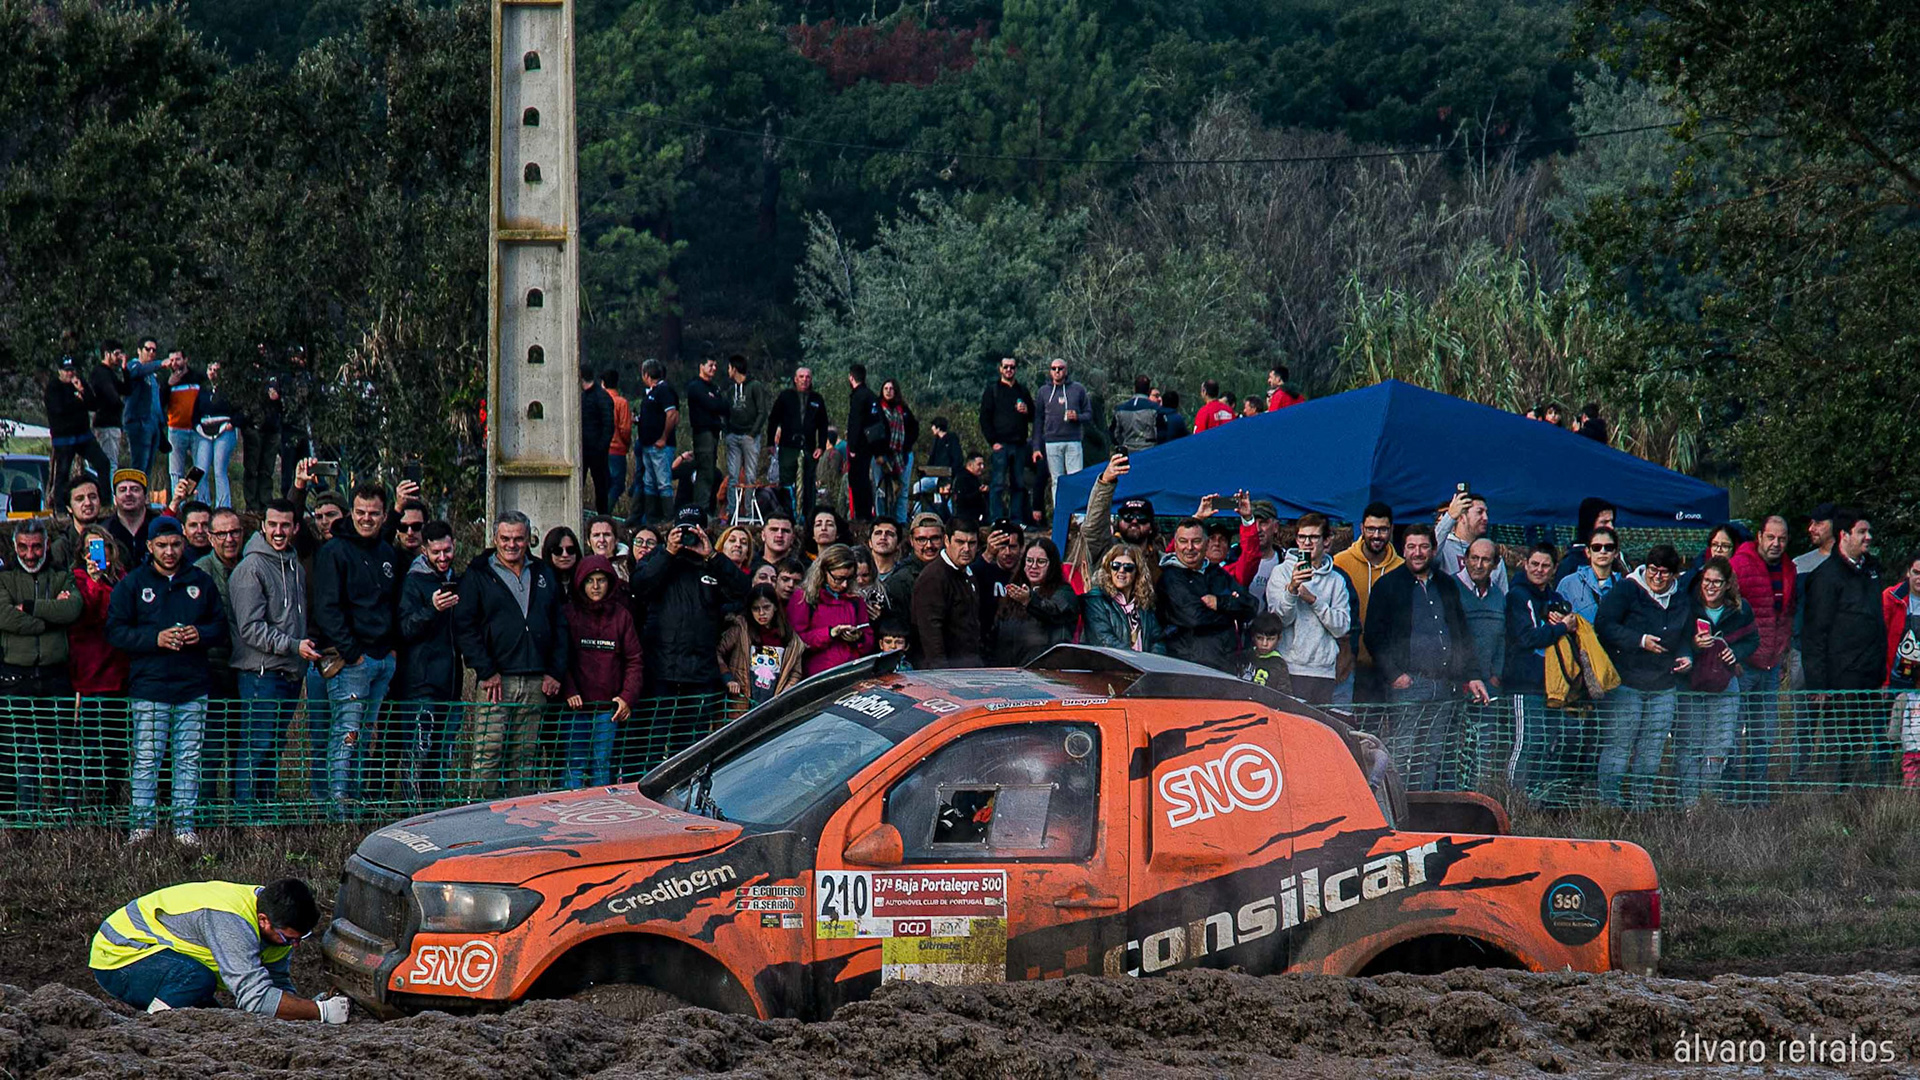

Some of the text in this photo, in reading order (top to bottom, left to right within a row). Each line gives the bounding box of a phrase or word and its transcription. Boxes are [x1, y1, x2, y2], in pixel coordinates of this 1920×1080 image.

[834, 691, 895, 720] Credibom
[1159, 743, 1283, 828] SNG
[607, 864, 737, 914] Credibom
[821, 874, 868, 917] 210
[874, 877, 1002, 895] 37ª Baja Portalegre 500
[898, 921, 926, 935] acp
[410, 939, 499, 992] SNG
